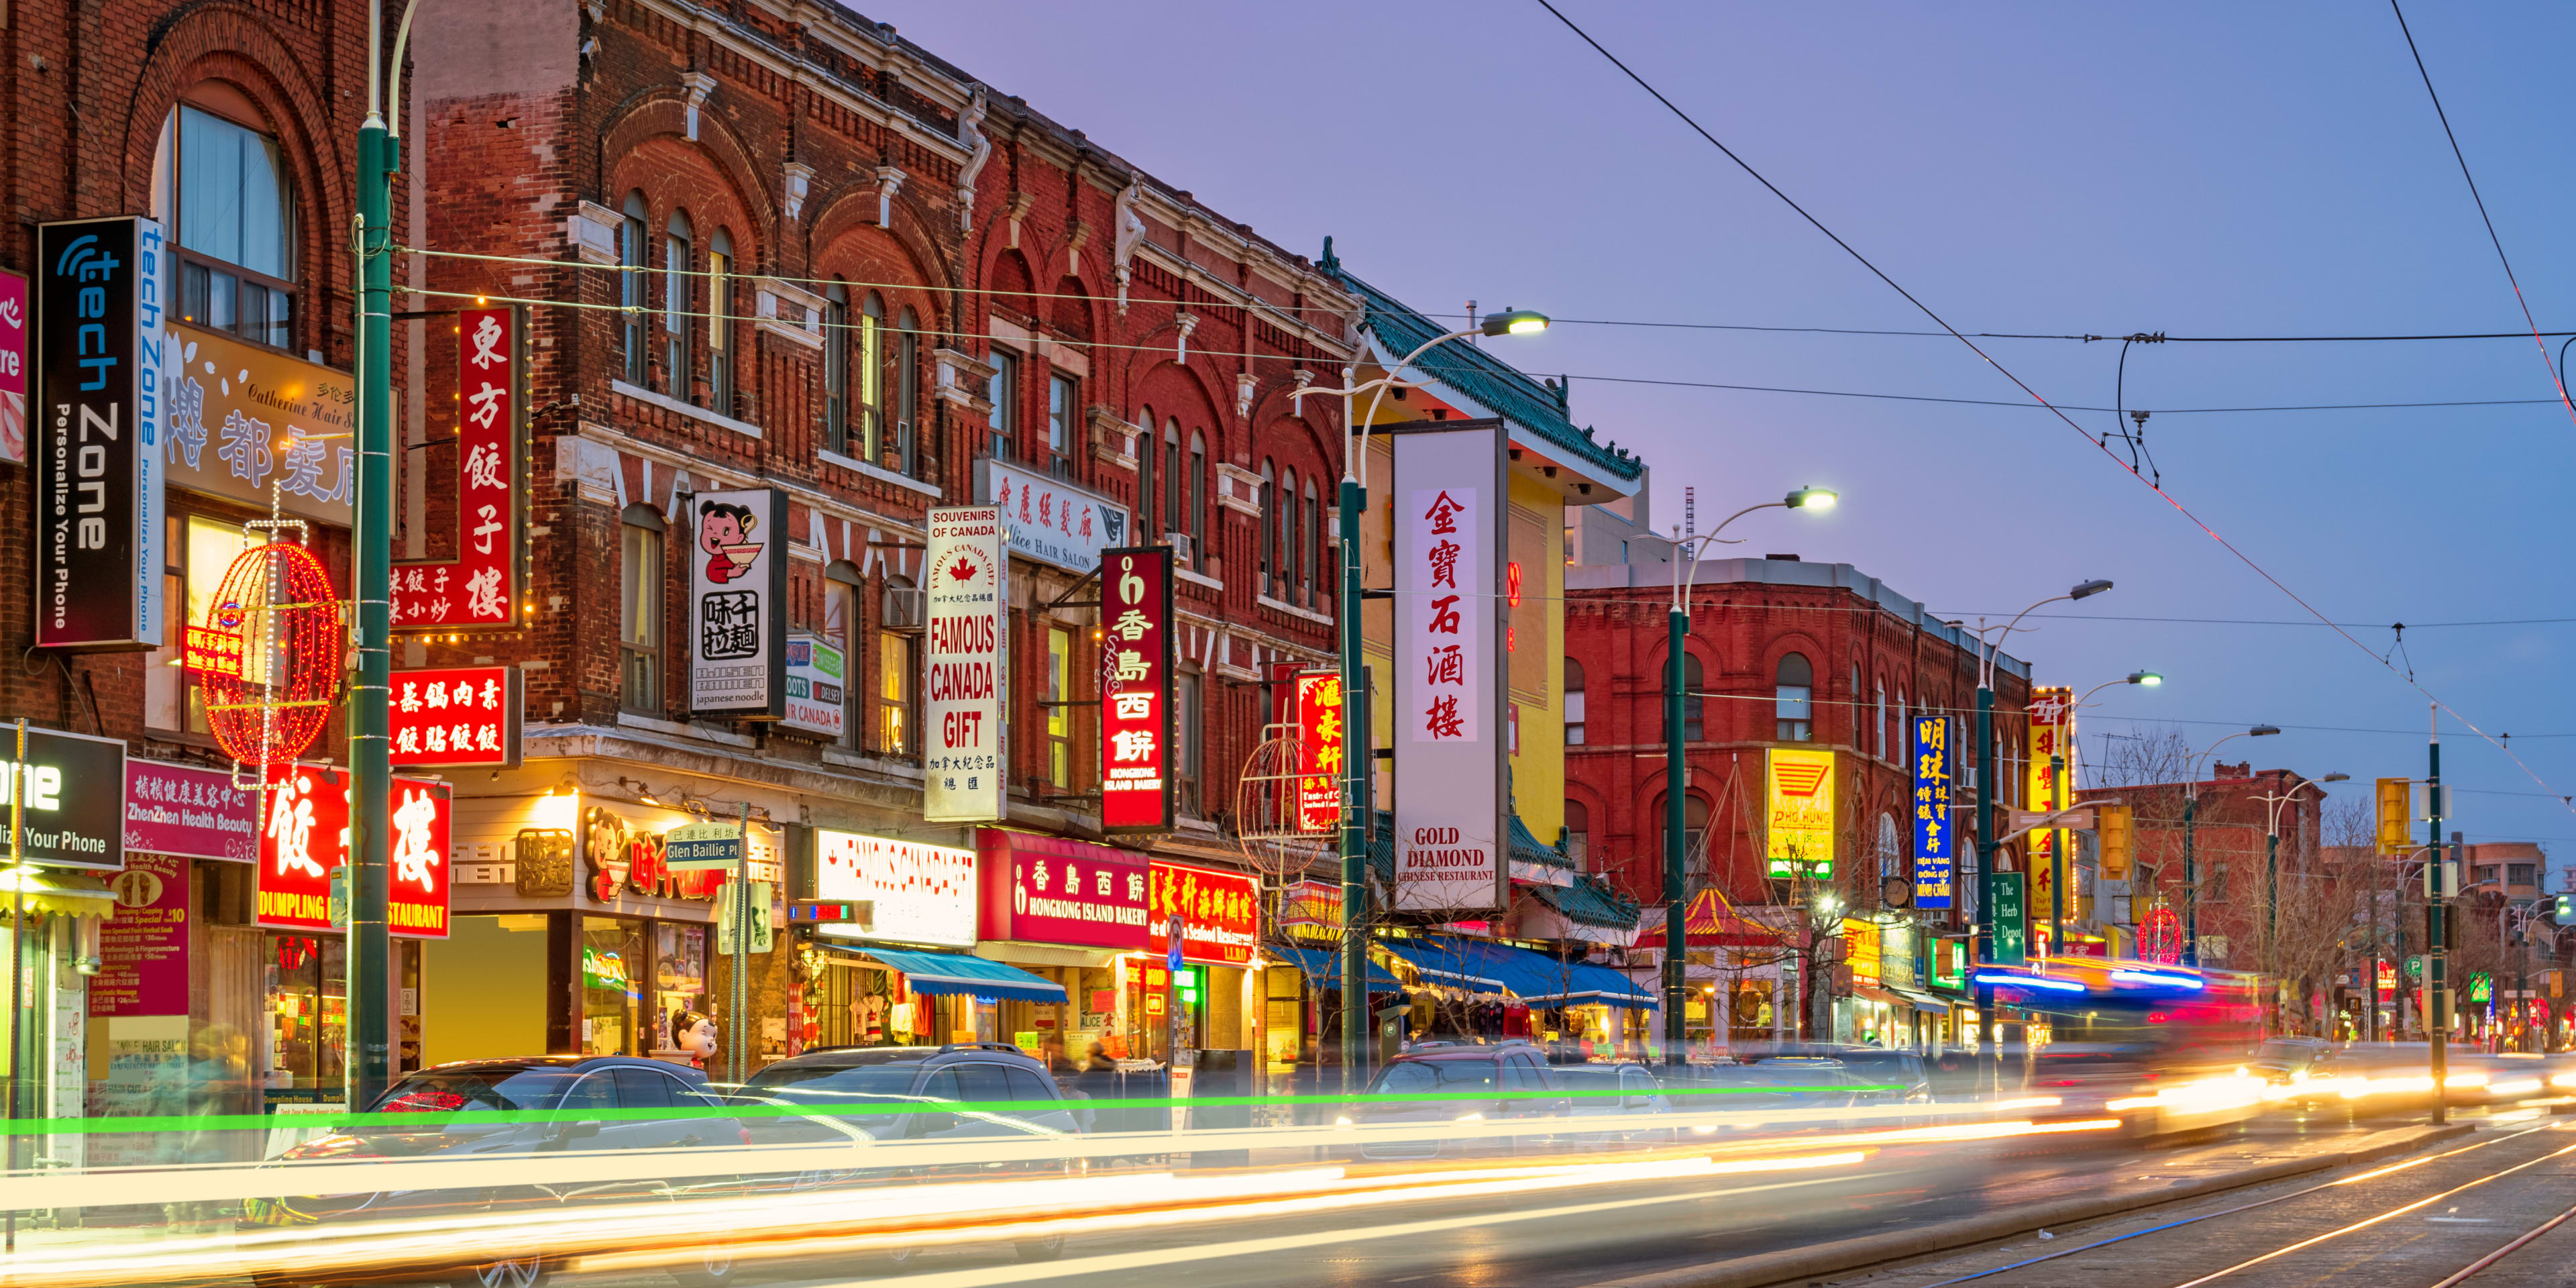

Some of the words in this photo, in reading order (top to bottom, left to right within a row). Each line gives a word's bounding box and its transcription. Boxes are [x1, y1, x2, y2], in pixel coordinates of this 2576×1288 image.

[142, 227, 162, 335] tech
[79, 251, 119, 391] tech
[0, 350, 19, 377] re
[141, 339, 161, 447] Zone
[249, 383, 307, 416] Catherine
[311, 402, 342, 425] Hair
[55, 403, 70, 516] Personalize
[464, 315, 508, 619] 東方餃子樓
[79, 402, 118, 550] Zone
[142, 458, 150, 545] Personalize
[933, 510, 996, 523] SOUVENIRS
[55, 519, 70, 564] Your
[932, 527, 947, 538] OF
[950, 525, 996, 537] CANADA
[141, 548, 150, 582] Your
[954, 543, 988, 562] CANADA
[985, 562, 995, 588] GIFT
[1035, 539, 1059, 559] HAIR
[1062, 547, 1090, 570] SALON
[55, 568, 70, 629] Phone
[141, 585, 150, 632] Phone
[1424, 489, 1466, 741] 金寶石酒樓
[931, 614, 994, 655] FAMOUS
[696, 665, 765, 679] AJISEN
[696, 678, 765, 691] RAMEN
[787, 676, 806, 696] OOTS
[930, 661, 994, 702] CANADA
[1111, 608, 1156, 762] 香島西餅
[696, 693, 735, 706] japanese
[735, 691, 765, 702] noodle
[821, 686, 841, 702] DELSEY
[798, 705, 832, 727] CANADA
[943, 711, 981, 748] GIFT
[1920, 718, 1950, 786] 明珠
[1104, 780, 1132, 791] ISLAND
[127, 802, 178, 825] ZhenZhen
[182, 808, 215, 829] Health
[217, 813, 253, 838] Beauty
[25, 827, 59, 849] Your
[62, 830, 106, 854] Phone
[1415, 827, 1460, 846] GOLD
[451, 842, 515, 861] SEN
[667, 845, 690, 859] Glen
[692, 843, 725, 857] Baillie
[729, 846, 737, 855] Pl
[1407, 849, 1485, 868] DIAMOND
[1032, 859, 1144, 902] 香島西餅
[1398, 871, 1437, 883] CHINESE
[1438, 870, 1494, 881] RESTAURANT
[2000, 882, 2014, 896] The
[259, 890, 324, 921] DUMPLING
[1029, 898, 1081, 920] HONGKONG
[1082, 903, 1114, 923] ISLAND
[1116, 906, 1148, 927] BAKERY
[2001, 903, 2018, 917] Herb
[134, 916, 162, 924] Special
[1188, 922, 1216, 943] Seafood
[2002, 925, 2022, 940] Depot
[1081, 1016, 1100, 1027] ALICE
[143, 1041, 160, 1053] HAIR
[264, 1095, 292, 1104] Dumpling
[293, 1095, 313, 1103] House
